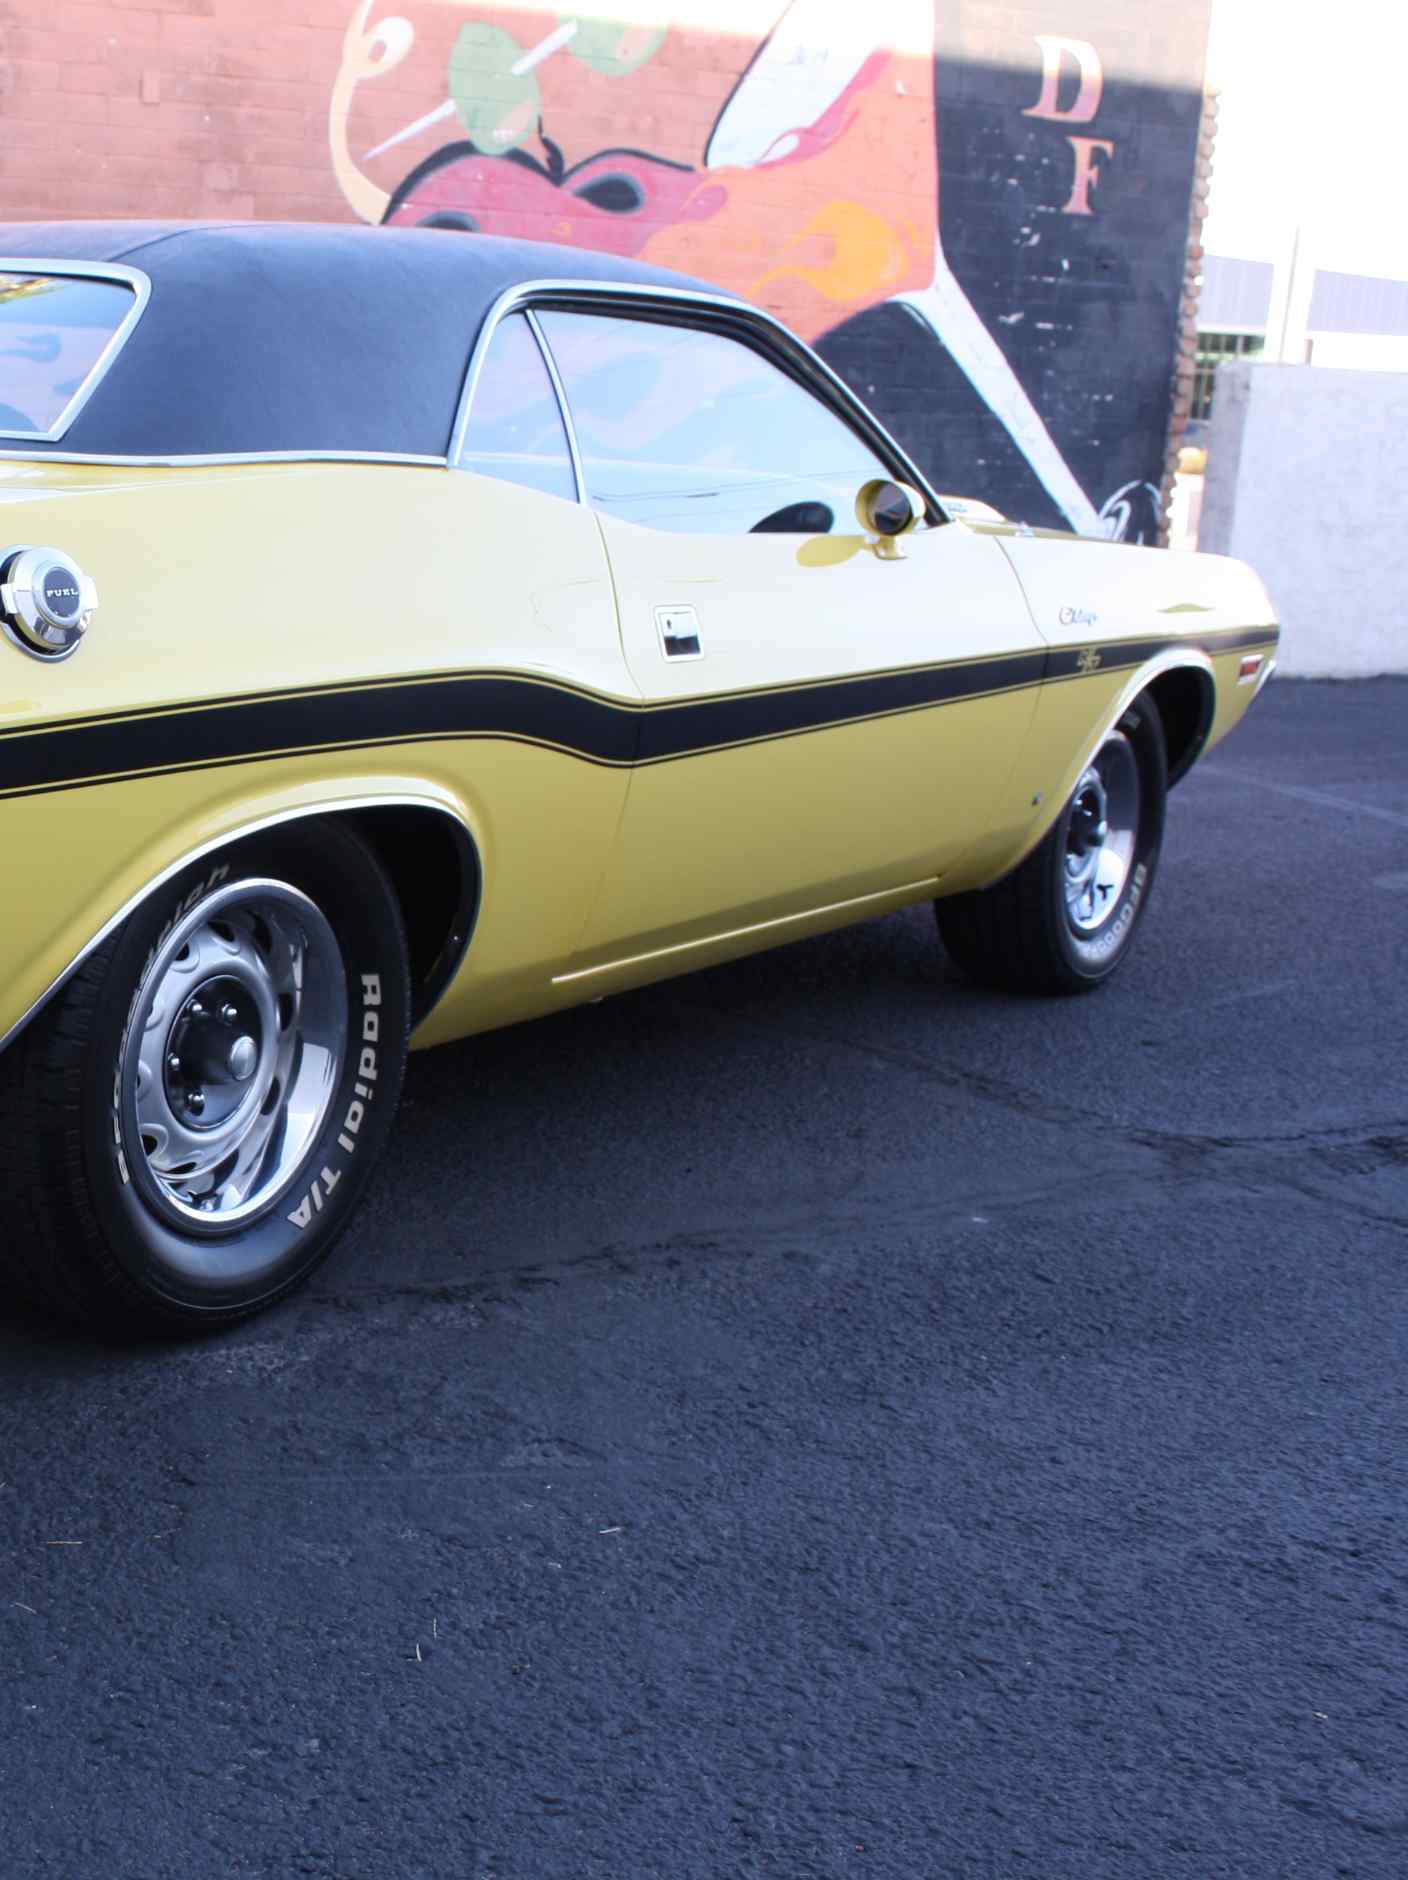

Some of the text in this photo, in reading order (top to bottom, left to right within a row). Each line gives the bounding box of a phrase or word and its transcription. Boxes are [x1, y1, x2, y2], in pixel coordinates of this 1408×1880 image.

[1021, 35, 1103, 123] D
[1062, 136, 1114, 214] F
[287, 973, 382, 1231] Radial T/A
